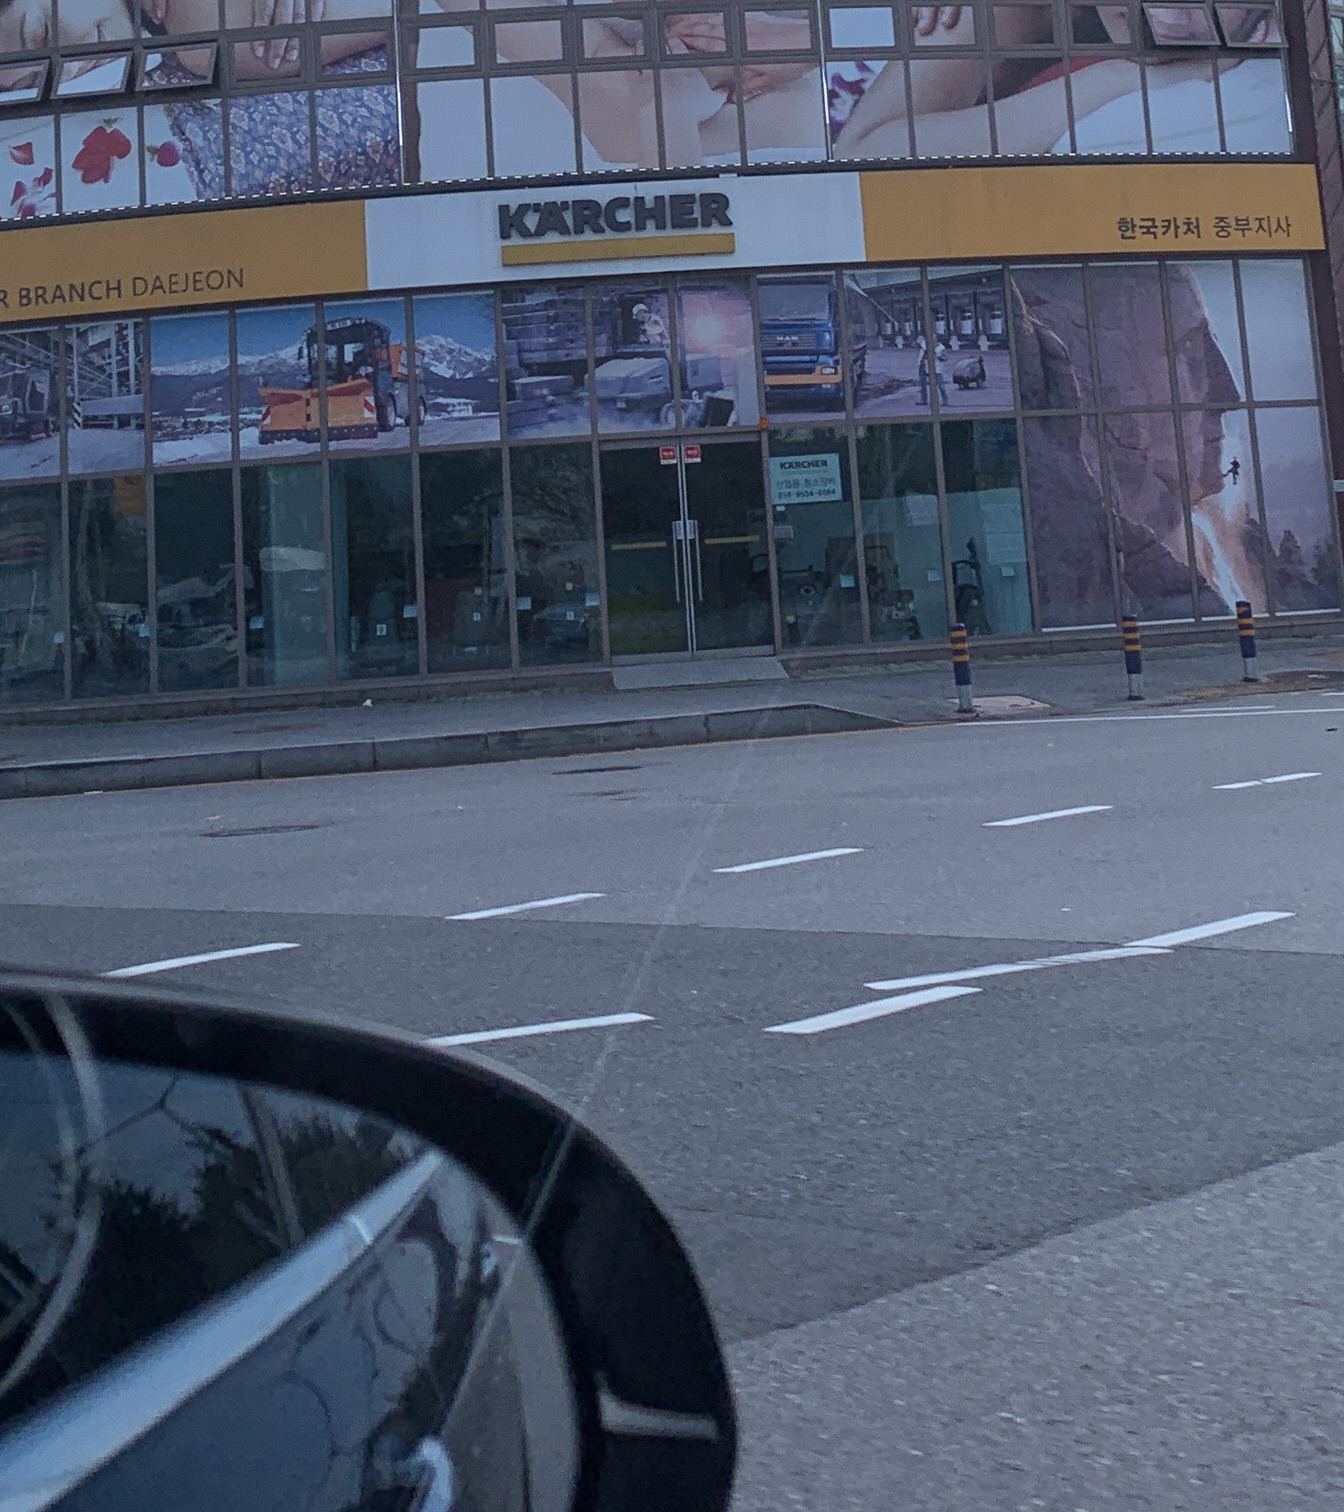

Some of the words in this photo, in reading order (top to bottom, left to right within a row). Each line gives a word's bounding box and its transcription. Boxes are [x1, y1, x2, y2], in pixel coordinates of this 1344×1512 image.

[1116, 215, 1201, 241] 한국카처
[1212, 214, 1292, 239] 중부지사
[18, 279, 122, 307] BRANCH
[132, 267, 245, 297] DAEJEON
